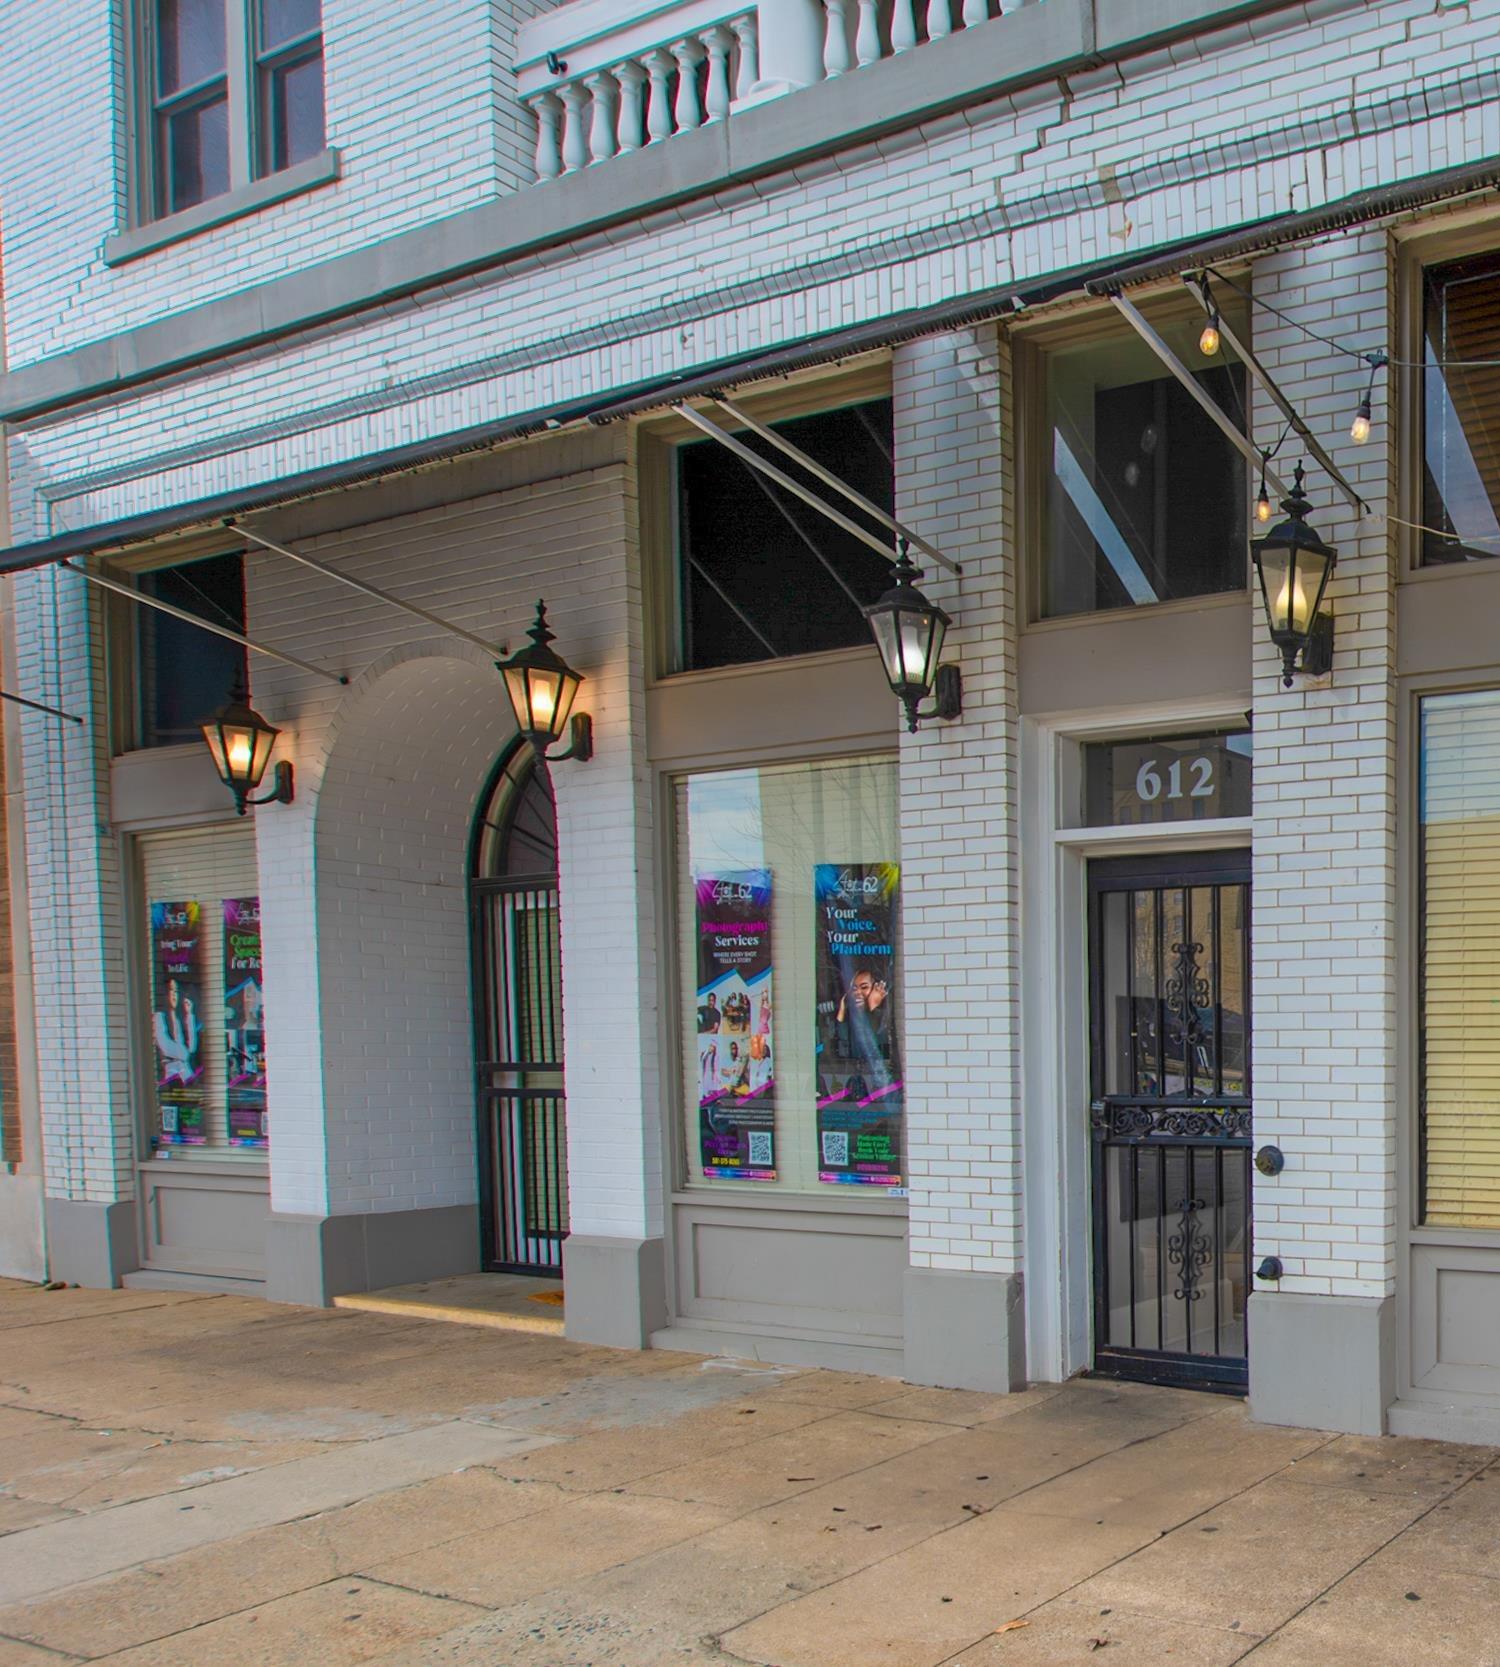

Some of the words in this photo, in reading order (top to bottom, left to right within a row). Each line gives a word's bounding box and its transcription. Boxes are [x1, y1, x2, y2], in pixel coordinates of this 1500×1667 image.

[1136, 757, 1215, 800] 612
[826, 907, 857, 919] Your
[715, 935, 759, 947] Services
[827, 931, 858, 943] Your
[831, 942, 894, 955] Platform
